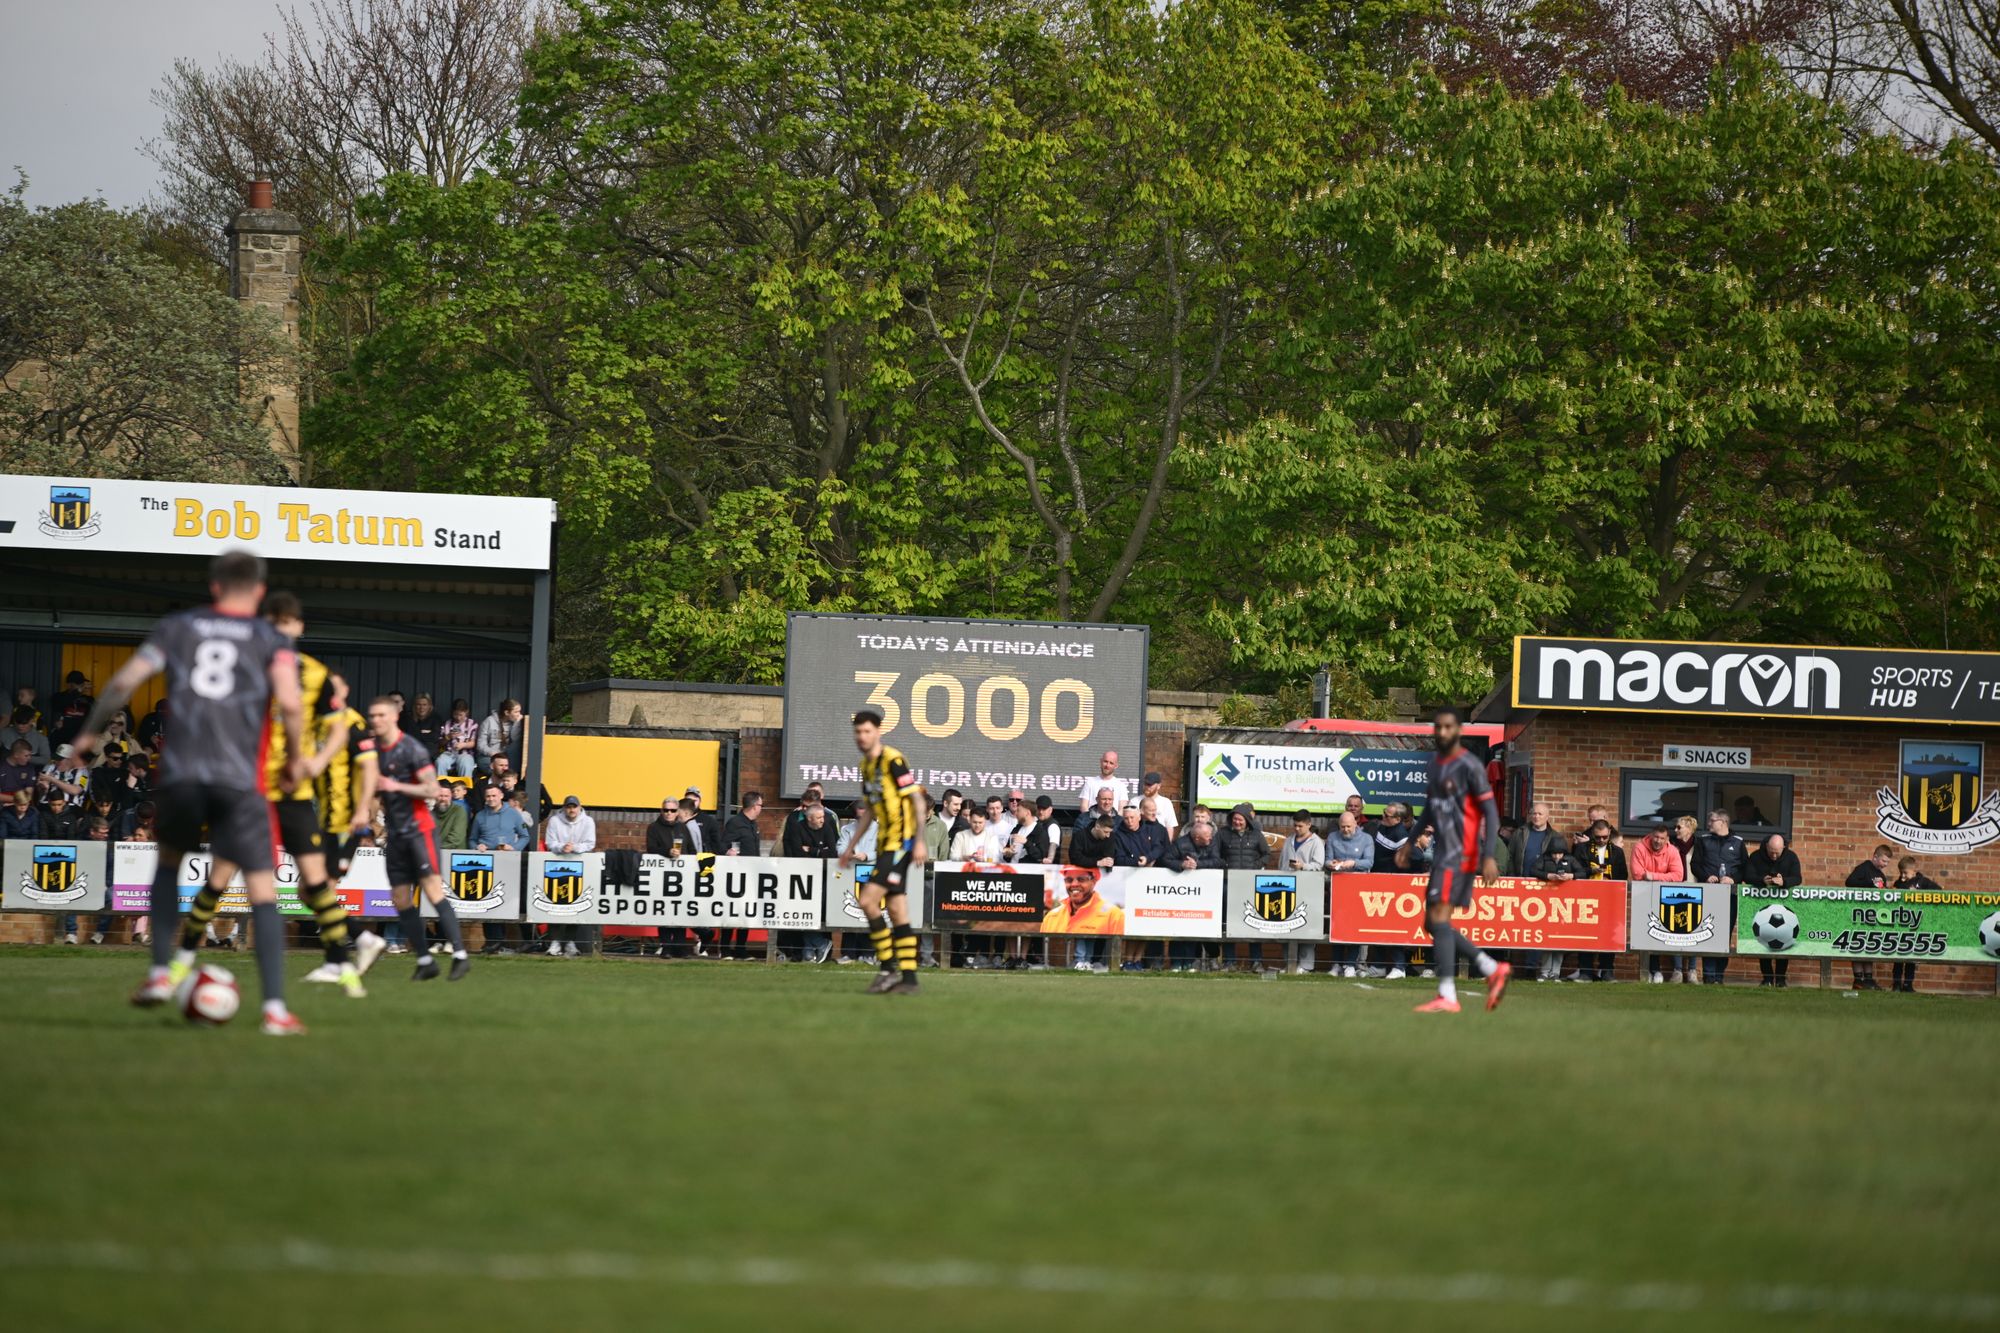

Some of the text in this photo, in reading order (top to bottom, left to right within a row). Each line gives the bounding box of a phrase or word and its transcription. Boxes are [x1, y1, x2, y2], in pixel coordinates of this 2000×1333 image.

[140, 497, 501, 550] The Bob Tatum Stand
[857, 633, 1095, 658] TODAY'S ATTENDANCE
[190, 638, 239, 701] 8
[1537, 646, 1841, 710] macron
[1870, 666, 1953, 688] SPORTS
[851, 670, 1095, 743] 3000
[1869, 688, 1918, 708] HUB
[1243, 754, 1335, 772] Trustmark
[1685, 750, 1747, 765] SNACKS
[799, 764, 864, 783] THAN
[928, 769, 972, 787] FOR
[976, 771, 1037, 790] YOUR
[1367, 769, 1400, 783] 0191
[1886, 821, 1994, 842] HEBBURN TOWN FC
[670, 859, 685, 868] TO
[601, 869, 813, 900] HEBBURN
[966, 880, 1012, 891] WE ARE
[1146, 885, 1201, 896] HITACHI
[951, 891, 1027, 903] RECRUITING!
[1742, 887, 1789, 898] PROUD
[1792, 888, 1880, 901] SUPPORTERS
[1883, 891, 1901, 902] OF
[1904, 893, 1970, 904] HEBBURN
[598, 898, 709, 917] SPORTS
[941, 902, 1036, 913] hitachicm.co.uk/careers
[1142, 909, 1205, 918] Reliable Solutions
[1358, 891, 1599, 924] WODSTONE
[1852, 906, 1923, 928] nearby
[1413, 926, 1544, 943] AREGATES
[1808, 930, 1948, 955] 0191 4555555
